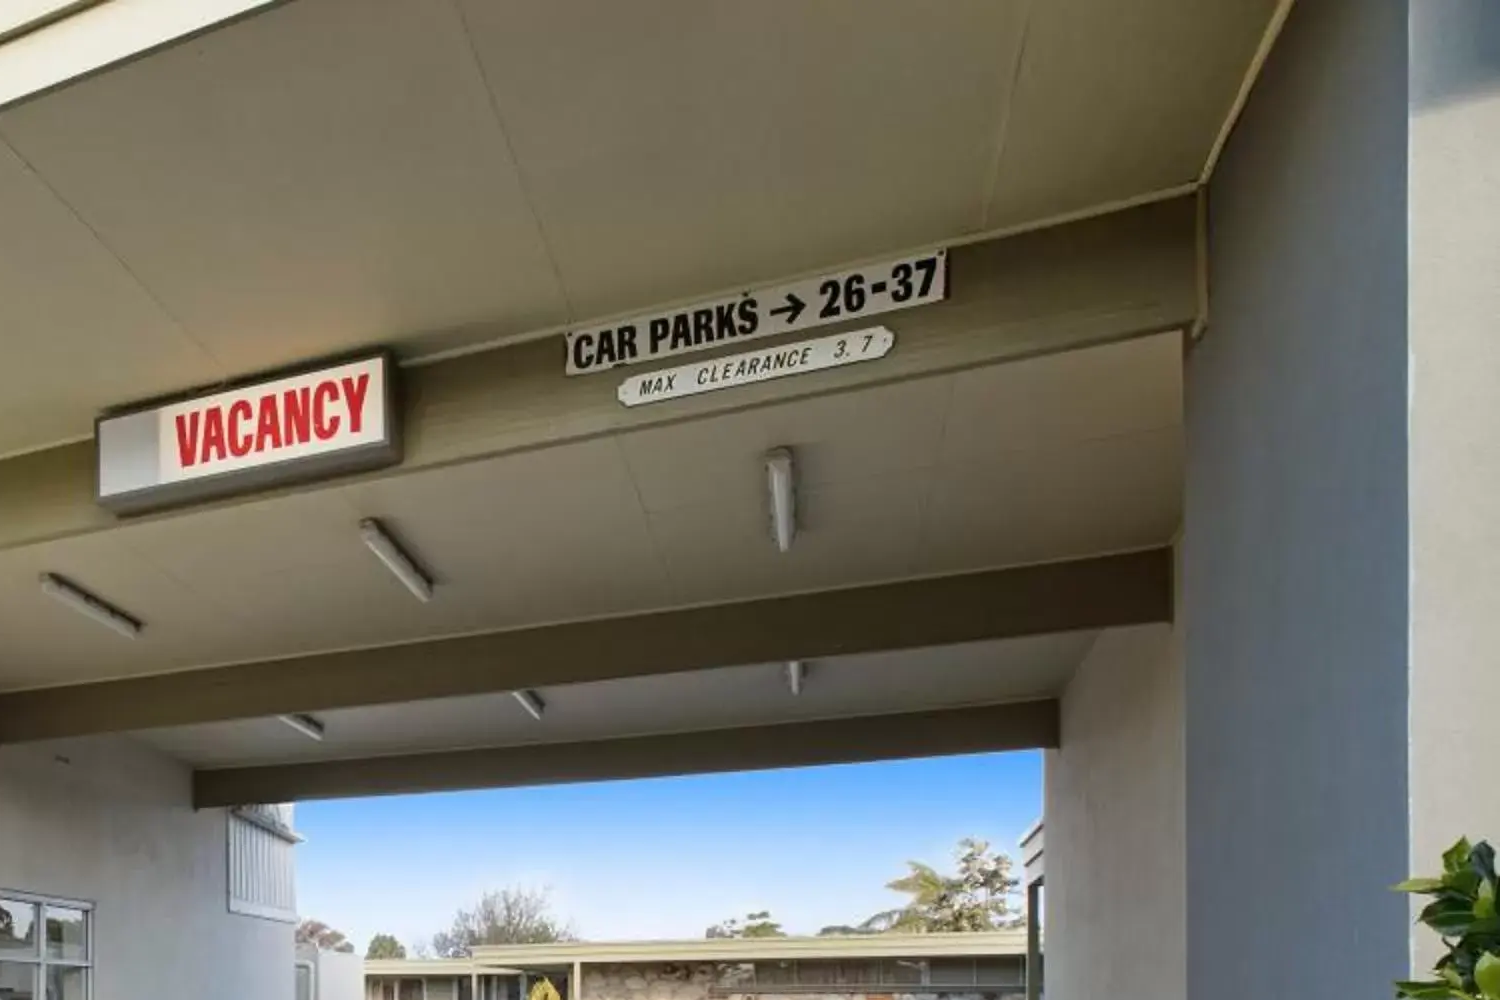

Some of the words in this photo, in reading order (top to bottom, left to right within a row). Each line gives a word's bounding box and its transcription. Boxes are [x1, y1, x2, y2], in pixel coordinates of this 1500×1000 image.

[573, 324, 638, 370] CAR
[649, 297, 759, 354] PARKS
[818, 257, 937, 319] 26-37
[639, 374, 677, 396] MAX
[697, 347, 812, 385] CLEARANCE
[175, 373, 370, 468] VACANCY
